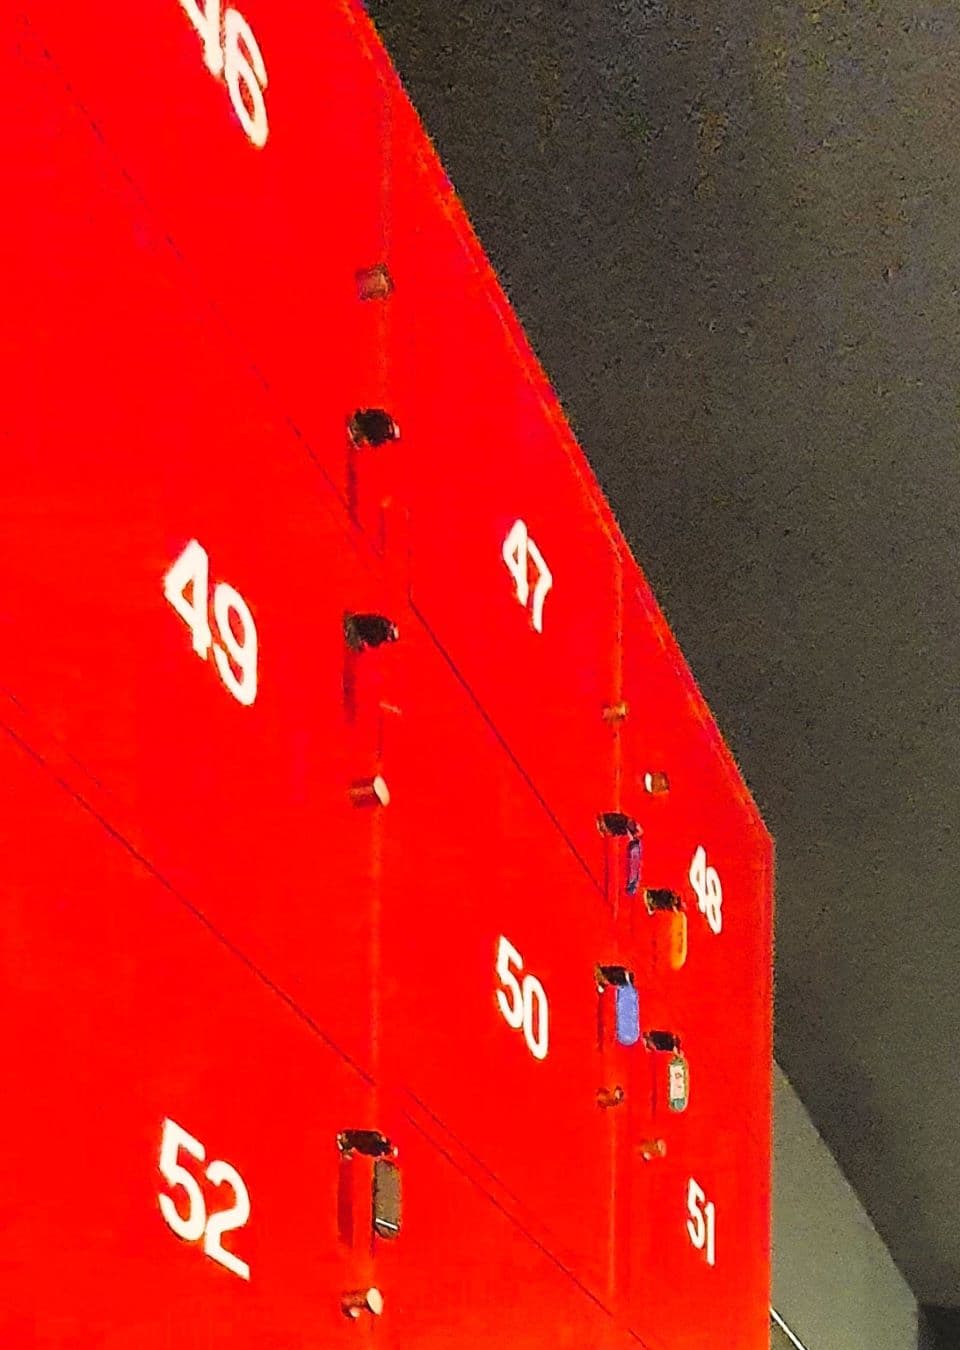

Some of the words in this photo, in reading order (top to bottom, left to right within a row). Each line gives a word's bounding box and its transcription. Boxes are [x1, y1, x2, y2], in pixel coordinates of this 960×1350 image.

[164, 539, 259, 706] 49
[502, 519, 553, 633] 47
[689, 845, 722, 934] 48
[496, 936, 549, 1060] 50
[157, 1117, 250, 1280] 52
[686, 1178, 715, 1266] 51
